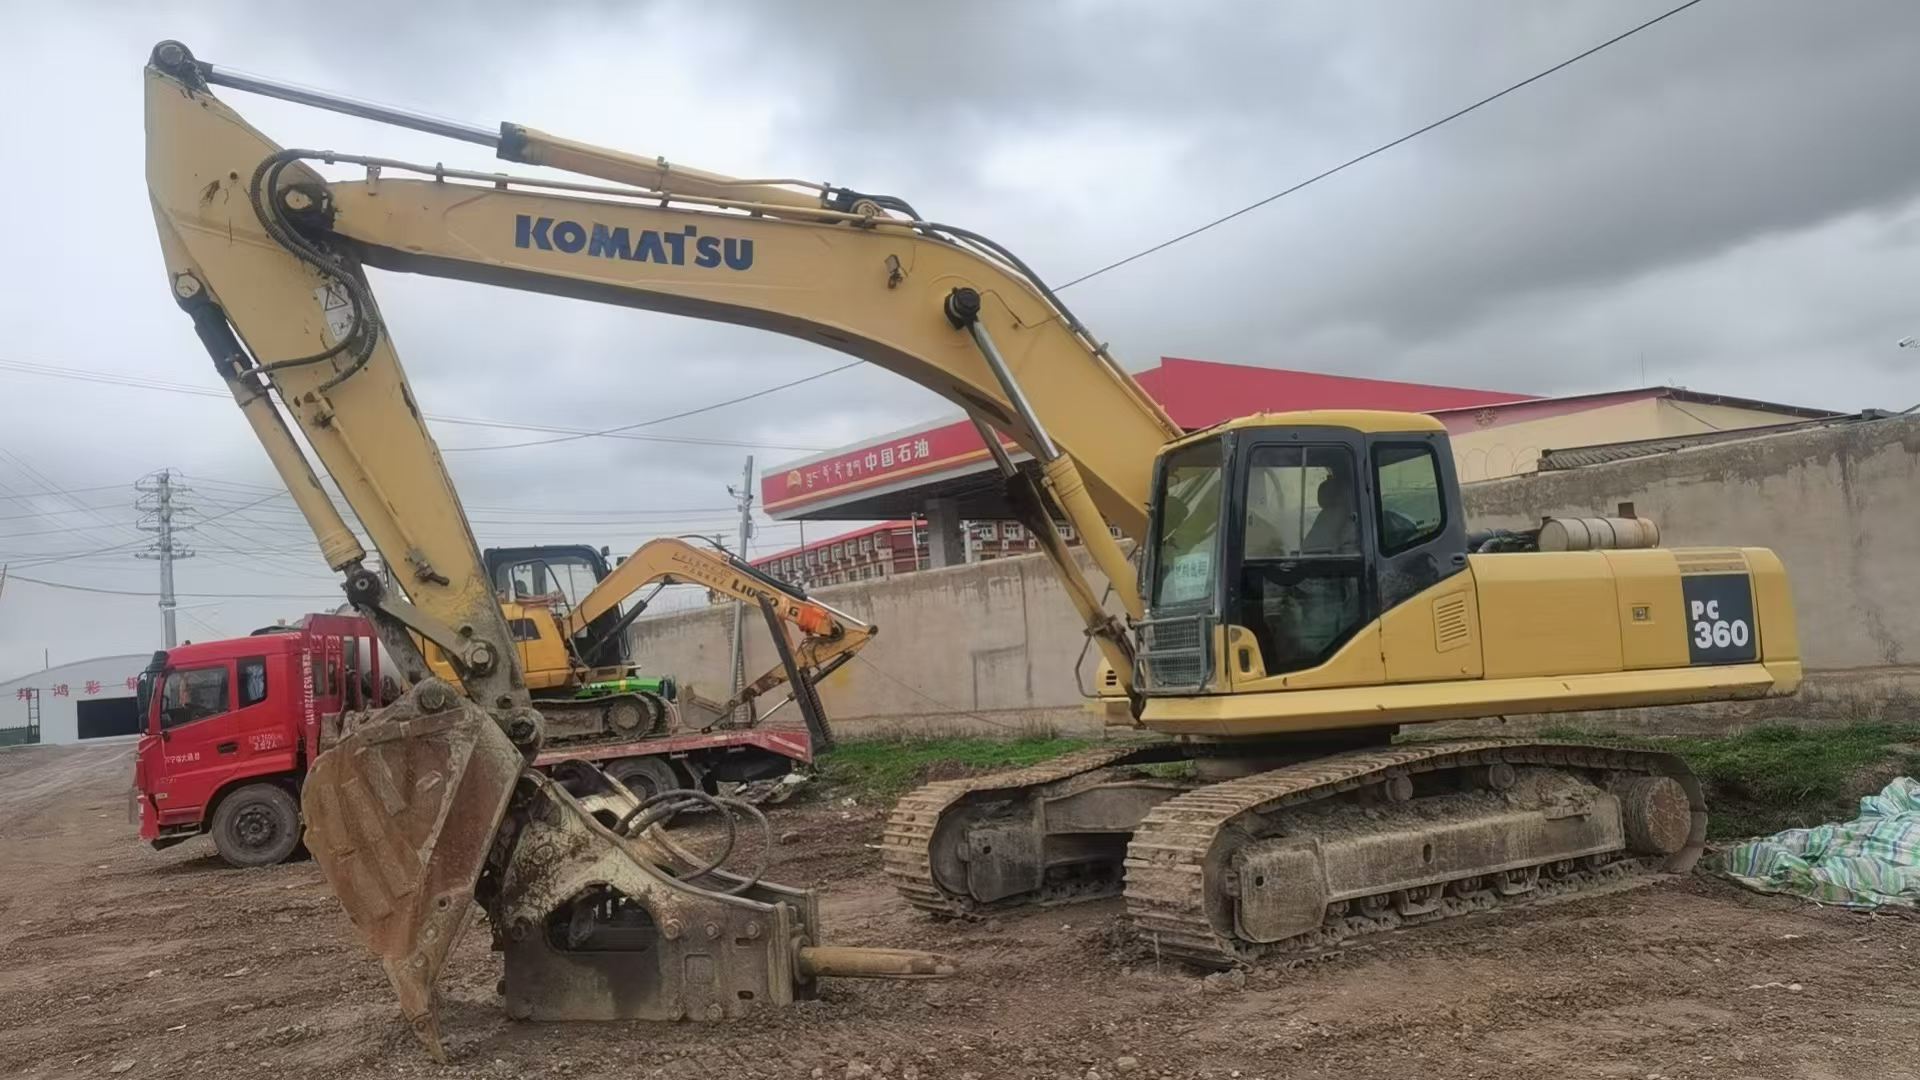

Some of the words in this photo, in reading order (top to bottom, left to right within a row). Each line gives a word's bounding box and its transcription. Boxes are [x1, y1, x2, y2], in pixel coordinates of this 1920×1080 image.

[515, 214, 753, 271] KOMATSU
[865, 438, 929, 471] 中国石油
[731, 578, 799, 617] LIUOG
[1691, 600, 1719, 620] PC
[1694, 619, 1749, 649] 360
